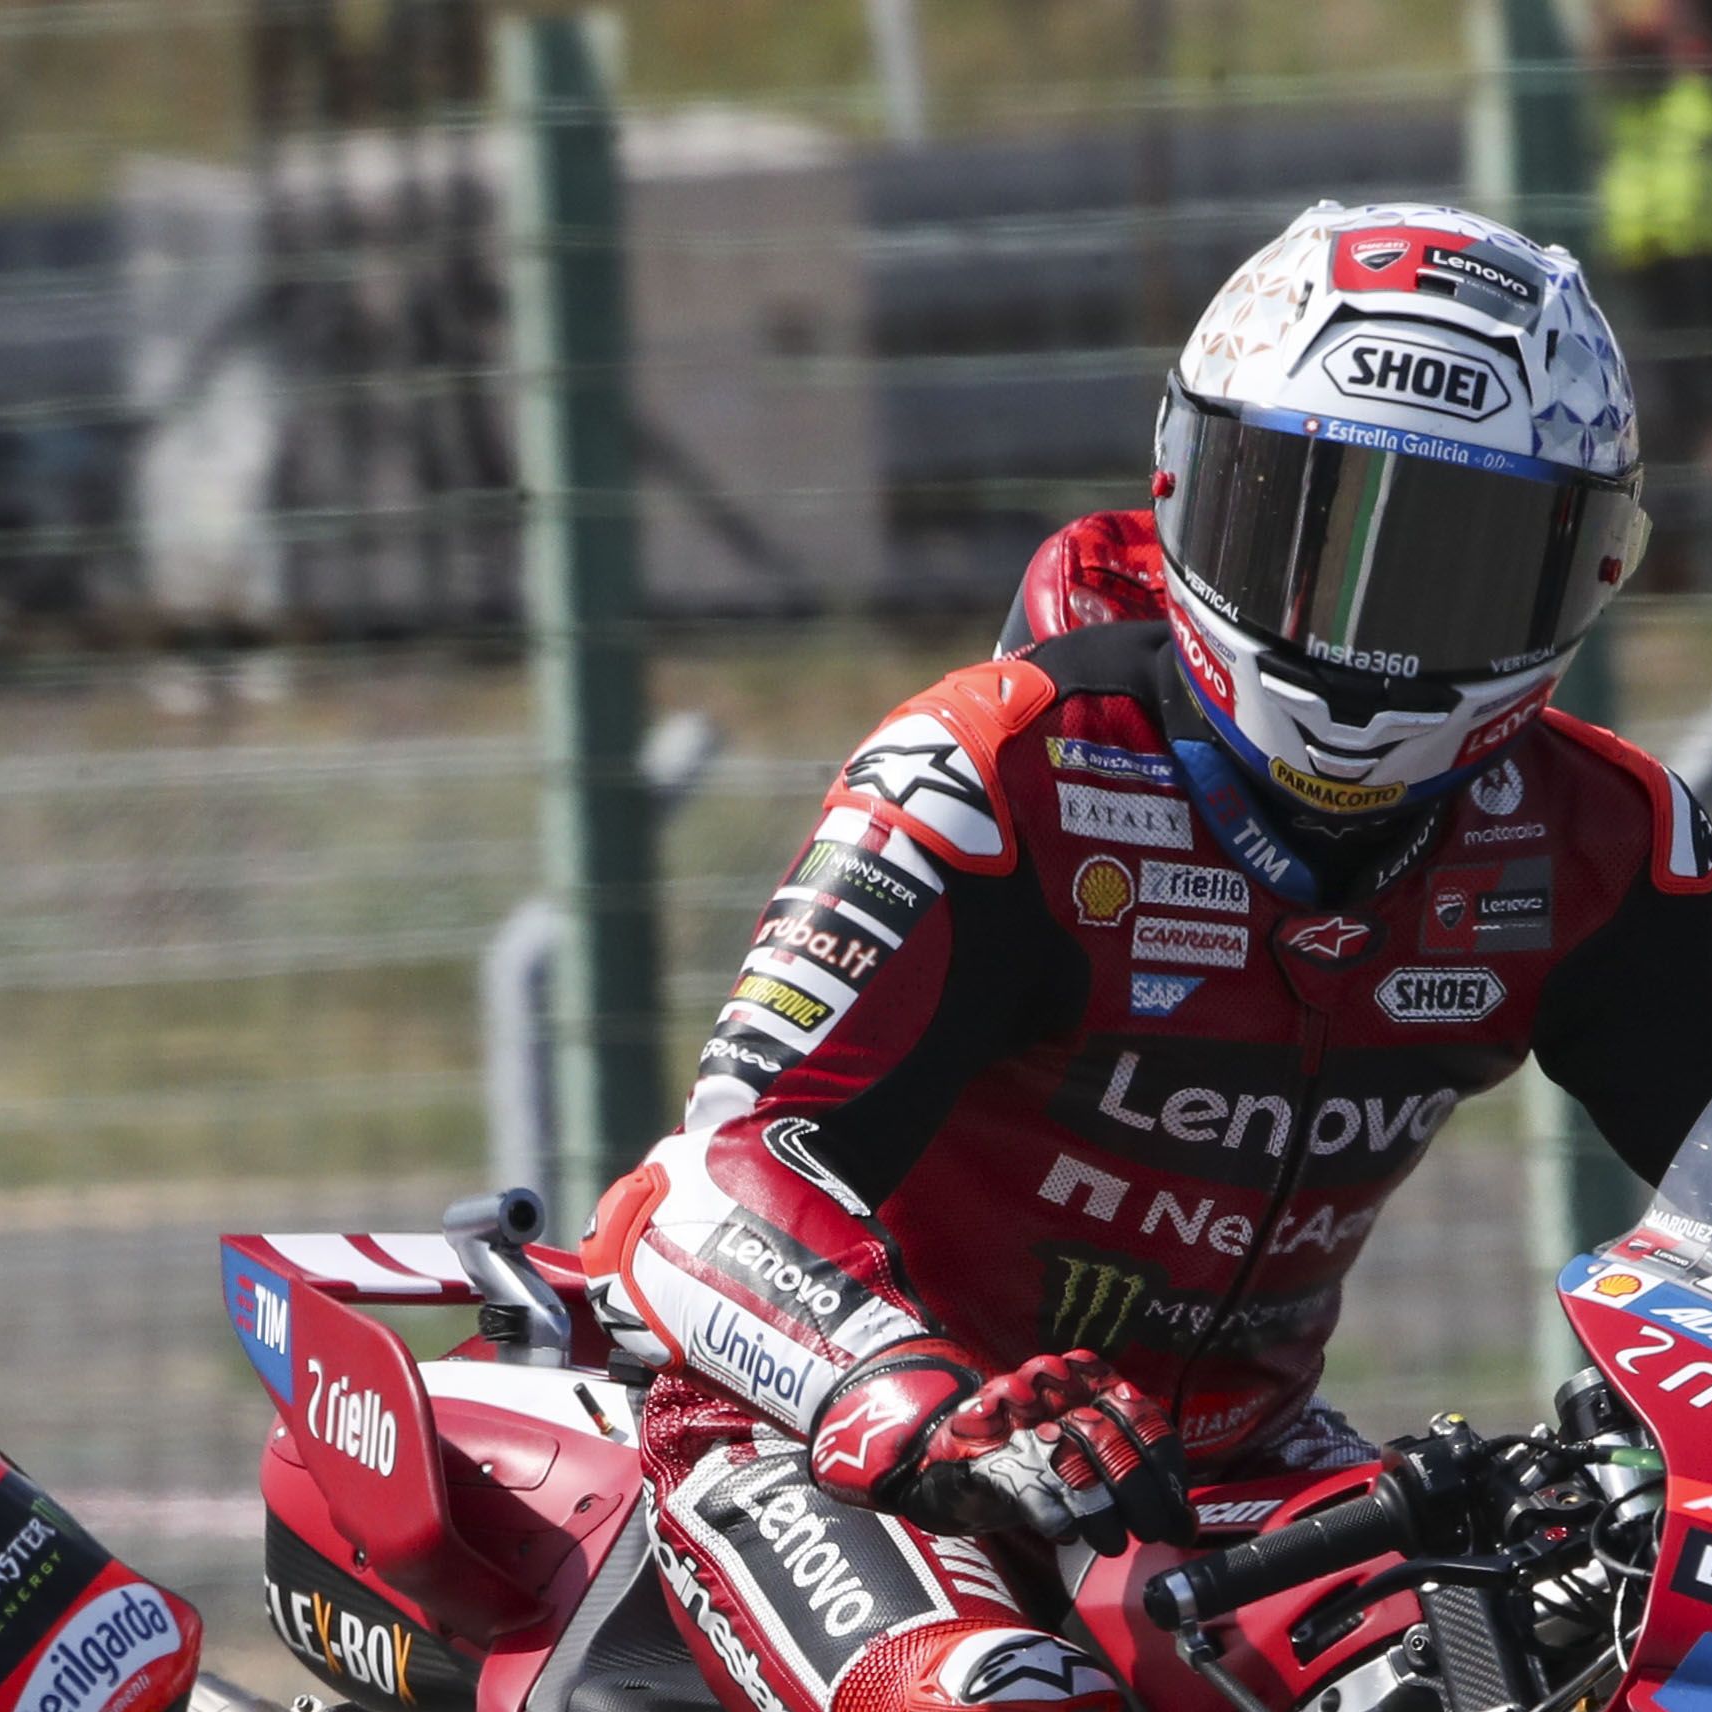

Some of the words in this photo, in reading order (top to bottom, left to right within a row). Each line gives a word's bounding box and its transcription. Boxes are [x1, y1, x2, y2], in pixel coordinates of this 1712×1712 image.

[1433, 249, 1529, 297] Lenovo
[1348, 346, 1489, 411] SHOEI
[1325, 420, 1399, 455] Estrella
[1401, 431, 1470, 466] Galicia
[1184, 571, 1239, 624] VERTICAL
[1306, 633, 1420, 679] Insta360
[1491, 645, 1557, 674] VERTICAL
[1275, 762, 1399, 809] PARMACOTTO
[1231, 819, 1291, 885] TIM
[1464, 820, 1545, 846] motorola
[830, 851, 918, 910] MONSTER
[1169, 868, 1247, 904] riello
[1480, 895, 1544, 914] Lenovo
[1136, 926, 1245, 955] CARRERA
[1394, 976, 1489, 1012] SHOEI
[1098, 1051, 1459, 1158] Lenovo
[717, 1222, 843, 1317] Lenovo
[253, 1283, 289, 1356] TIM
[705, 1301, 813, 1409] Unipol
[326, 1375, 399, 1478] riello
[732, 1461, 875, 1639] Lenovo
[264, 1570, 415, 1706] LEX-BOX
